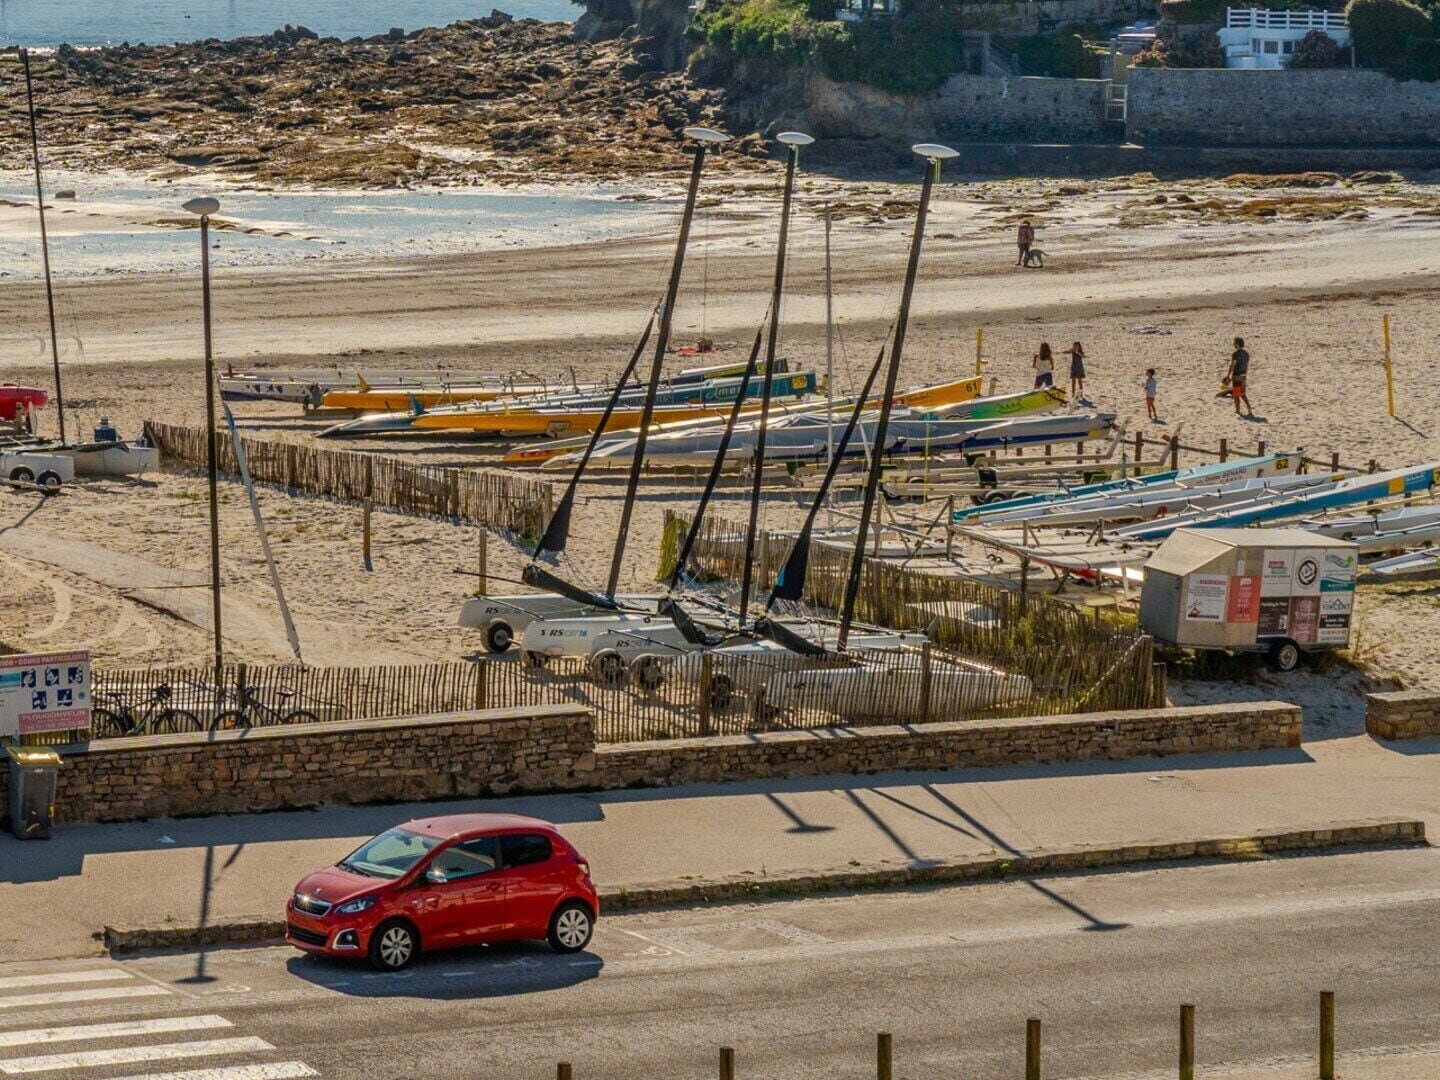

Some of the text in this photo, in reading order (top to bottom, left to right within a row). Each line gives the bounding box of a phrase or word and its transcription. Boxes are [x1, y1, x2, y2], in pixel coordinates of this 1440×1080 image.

[965, 381, 978, 393] 61
[18, 657, 41, 666] COURS
[42, 653, 87, 664] PARTICULIERS
[23, 710, 86, 721] PLOUGONVELIN
